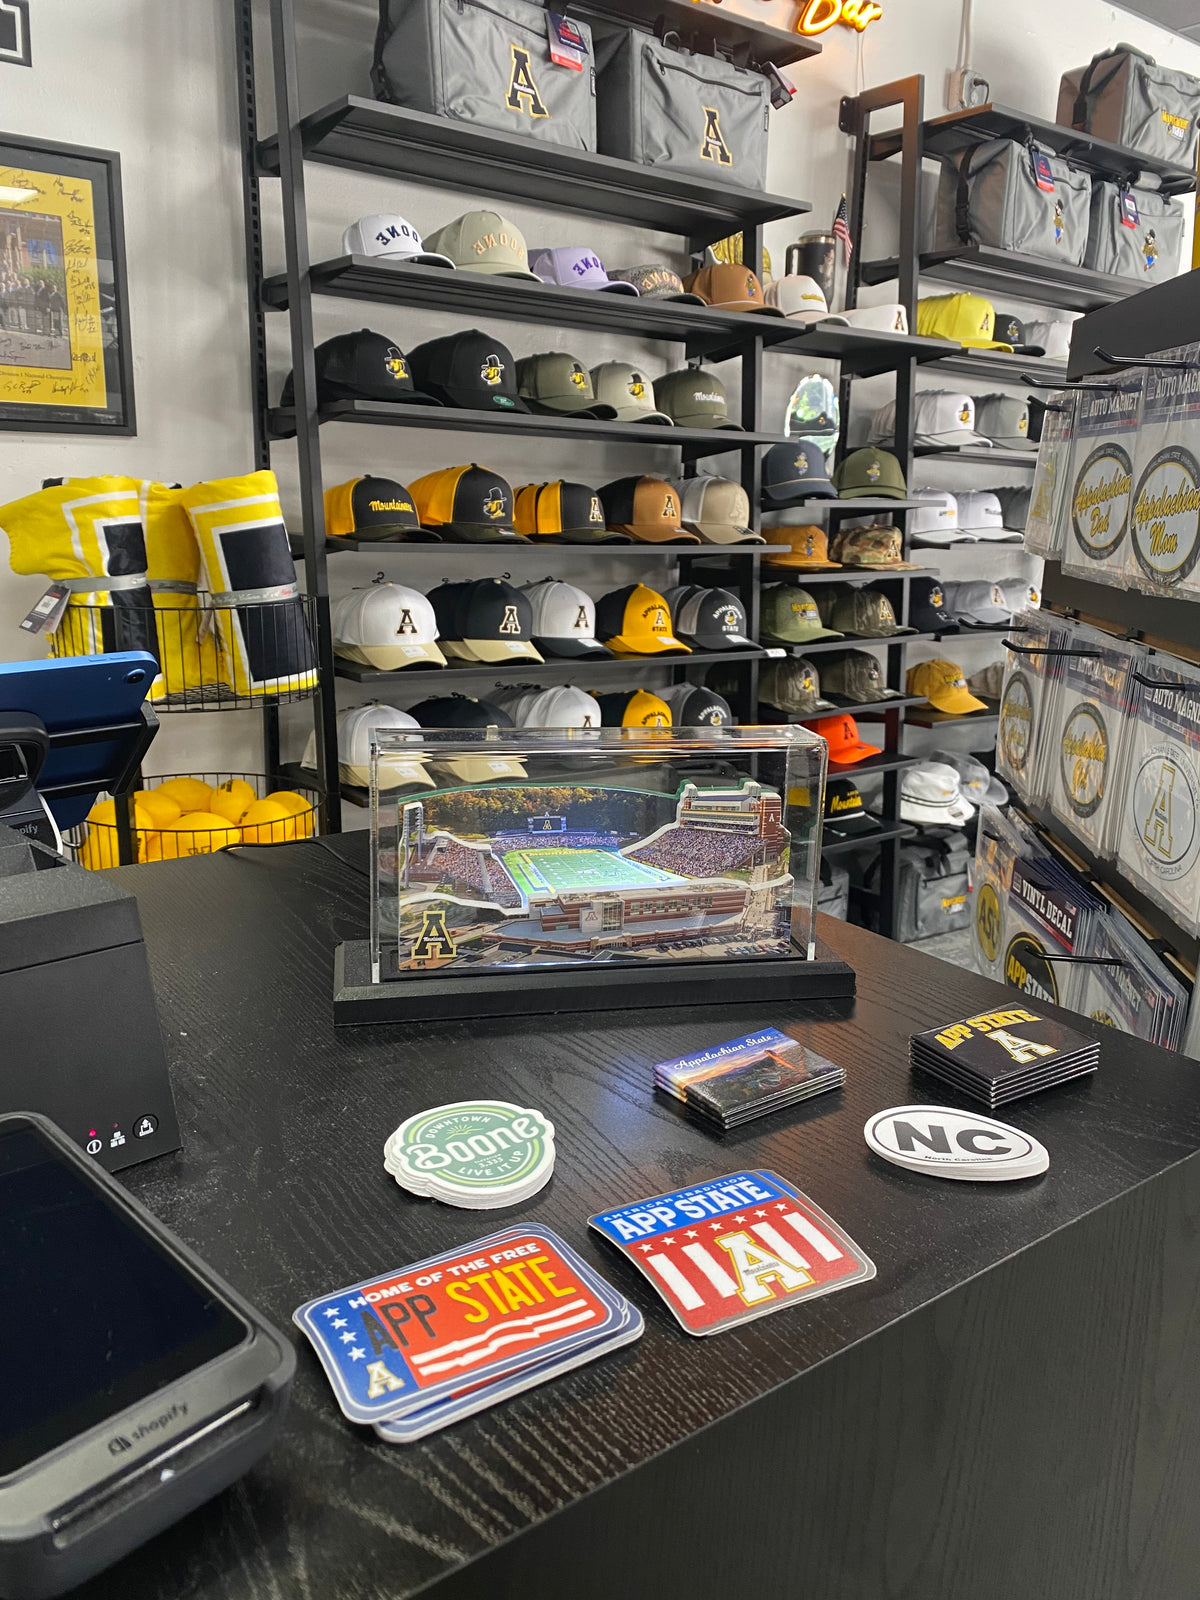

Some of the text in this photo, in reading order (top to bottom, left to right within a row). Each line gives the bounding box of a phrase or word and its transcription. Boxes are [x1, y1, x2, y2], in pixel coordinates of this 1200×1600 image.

[505, 44, 552, 119] A
[700, 106, 733, 166] A
[1155, 376, 1177, 399] AUTO
[1089, 398, 1108, 417] AUTO
[589, 496, 603, 522] A
[661, 493, 676, 518] A
[1074, 467, 1132, 518] Appalachian
[1133, 477, 1200, 531] Appalachian
[1090, 505, 1111, 538] Dad
[1149, 521, 1178, 556] Mom
[396, 607, 418, 636] A
[499, 605, 521, 634] A
[573, 604, 590, 629] A
[1153, 688, 1174, 709] AUTO
[1143, 762, 1176, 858] A
[1022, 879, 1045, 914] VINYL
[1045, 900, 1073, 939] DECAL
[411, 910, 457, 960] A
[934, 1009, 1043, 1051] APP STATE
[984, 1028, 1060, 1065] A
[674, 1035, 774, 1071] Appalachian State
[405, 1116, 540, 1170] Boone
[425, 1115, 492, 1139] DOWNTOWN
[893, 1120, 1013, 1156] NC
[457, 1150, 524, 1176] LIVE IT UP
[603, 1176, 748, 1223] AMERICAN TRADITION
[610, 1180, 775, 1241] APP STATE
[348, 1243, 541, 1309] HOME OF THE FREE
[714, 1230, 817, 1308] A
[359, 1255, 577, 1356] APP STATE
[366, 1360, 405, 1399] A
[131, 1402, 189, 1440] shopify
